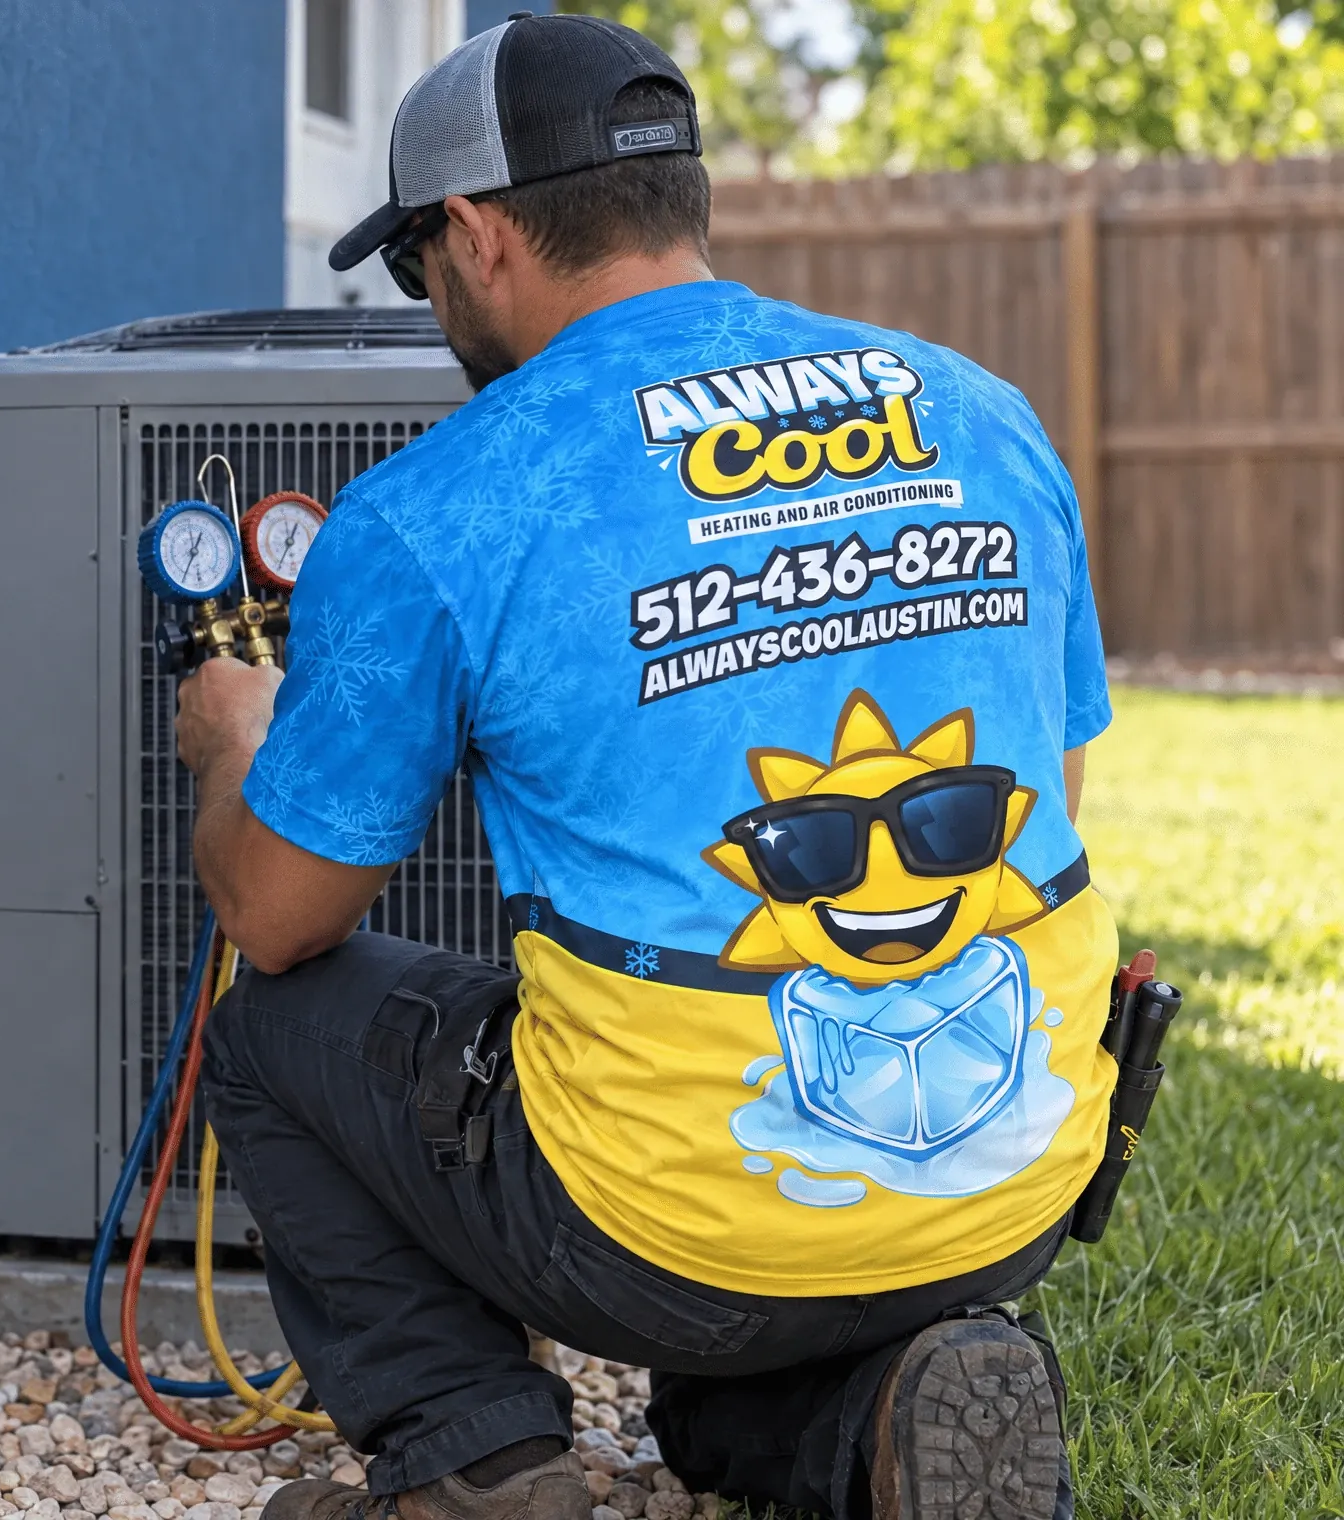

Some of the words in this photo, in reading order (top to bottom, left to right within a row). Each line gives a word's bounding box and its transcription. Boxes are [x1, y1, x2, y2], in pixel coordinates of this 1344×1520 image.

[640, 349, 921, 442] ALWAYS
[686, 393, 937, 497] Cool
[700, 512, 773, 537] HEATING
[777, 507, 809, 524] AND
[813, 501, 840, 519] AIR
[844, 484, 954, 512] CONDITIONING
[637, 525, 1014, 645] 512-436-8272
[643, 592, 1025, 698] ALWAYSCOOLAUSTIN.COM
